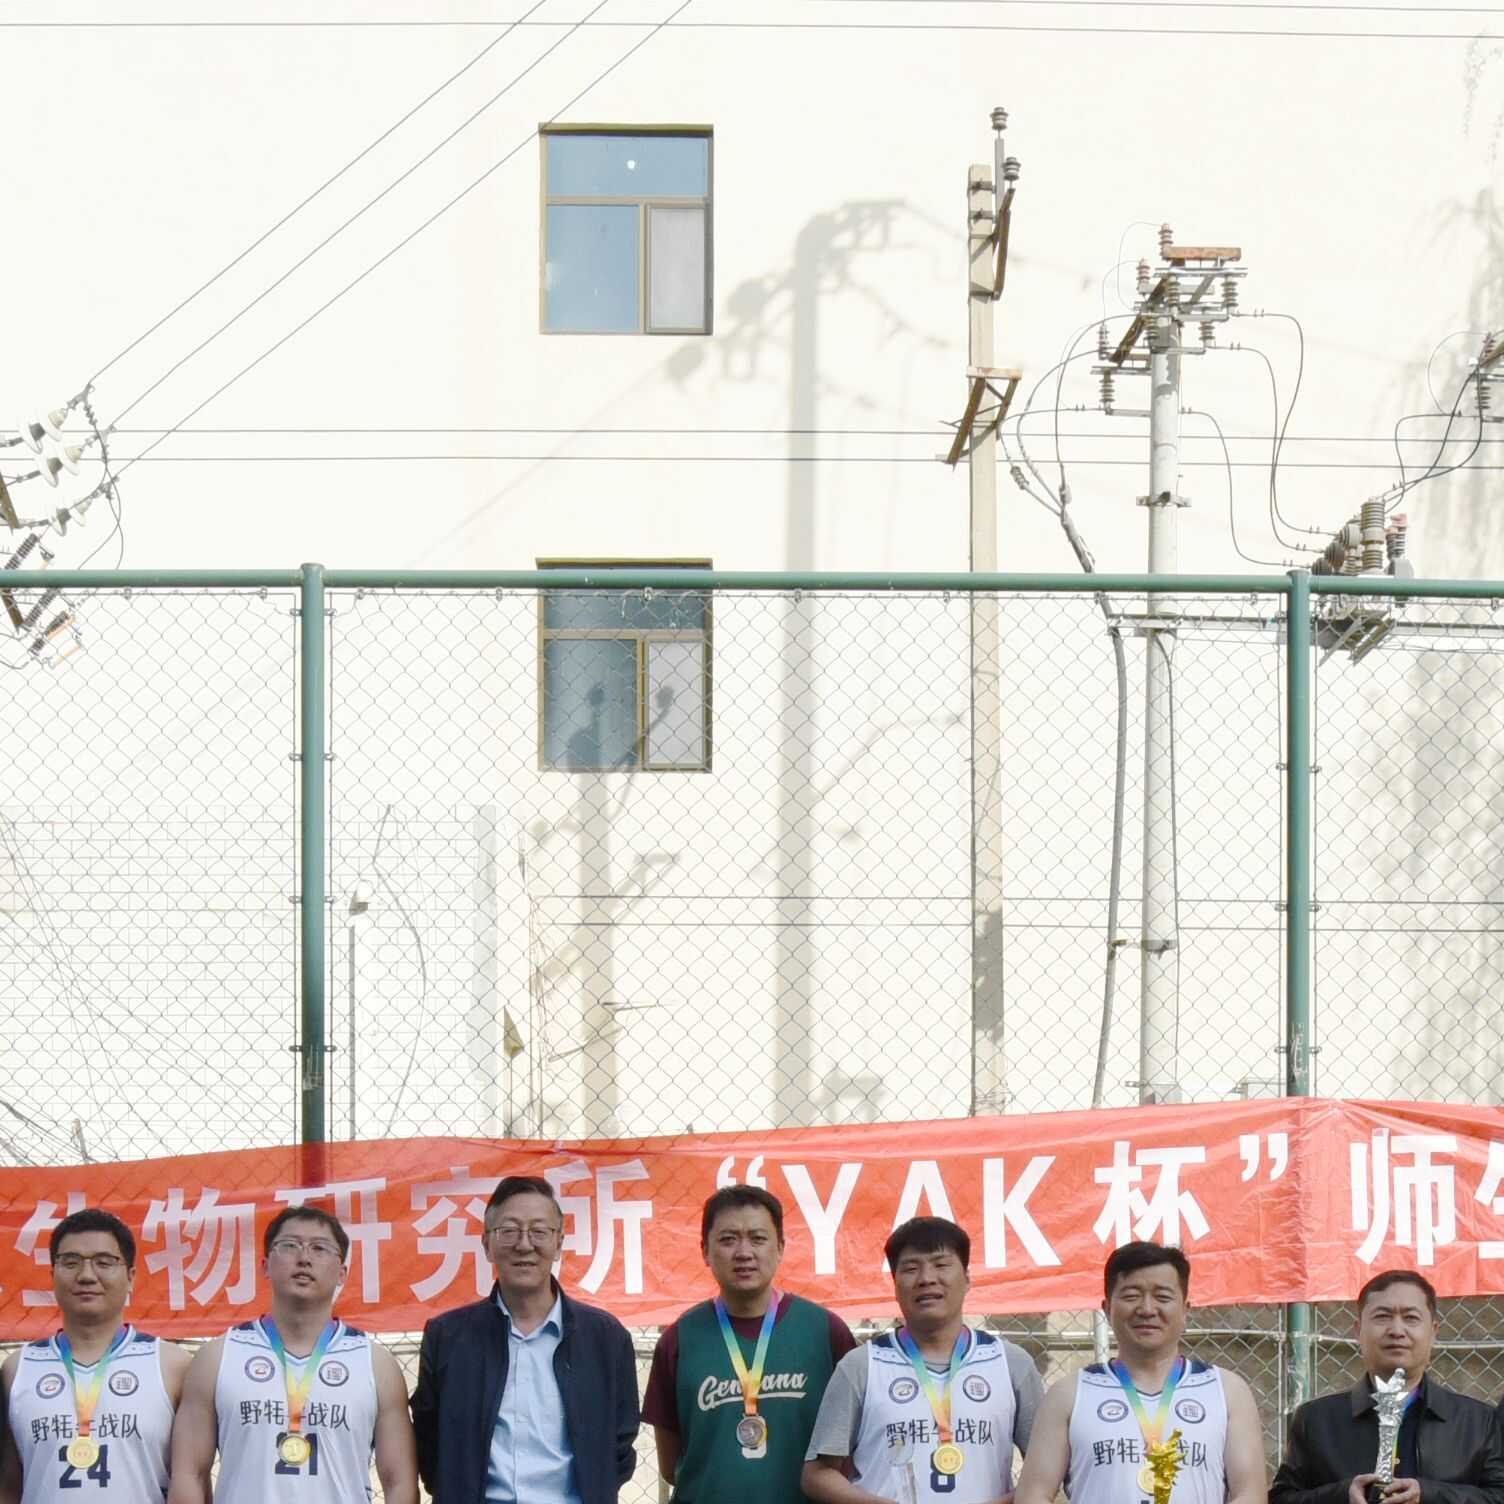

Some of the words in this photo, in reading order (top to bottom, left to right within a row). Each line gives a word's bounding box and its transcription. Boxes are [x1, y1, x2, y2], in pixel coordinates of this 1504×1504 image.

[698, 1370, 808, 1411] Genana
[58, 1443, 112, 1489] 24
[1093, 1437, 1208, 1472] 野牦队
